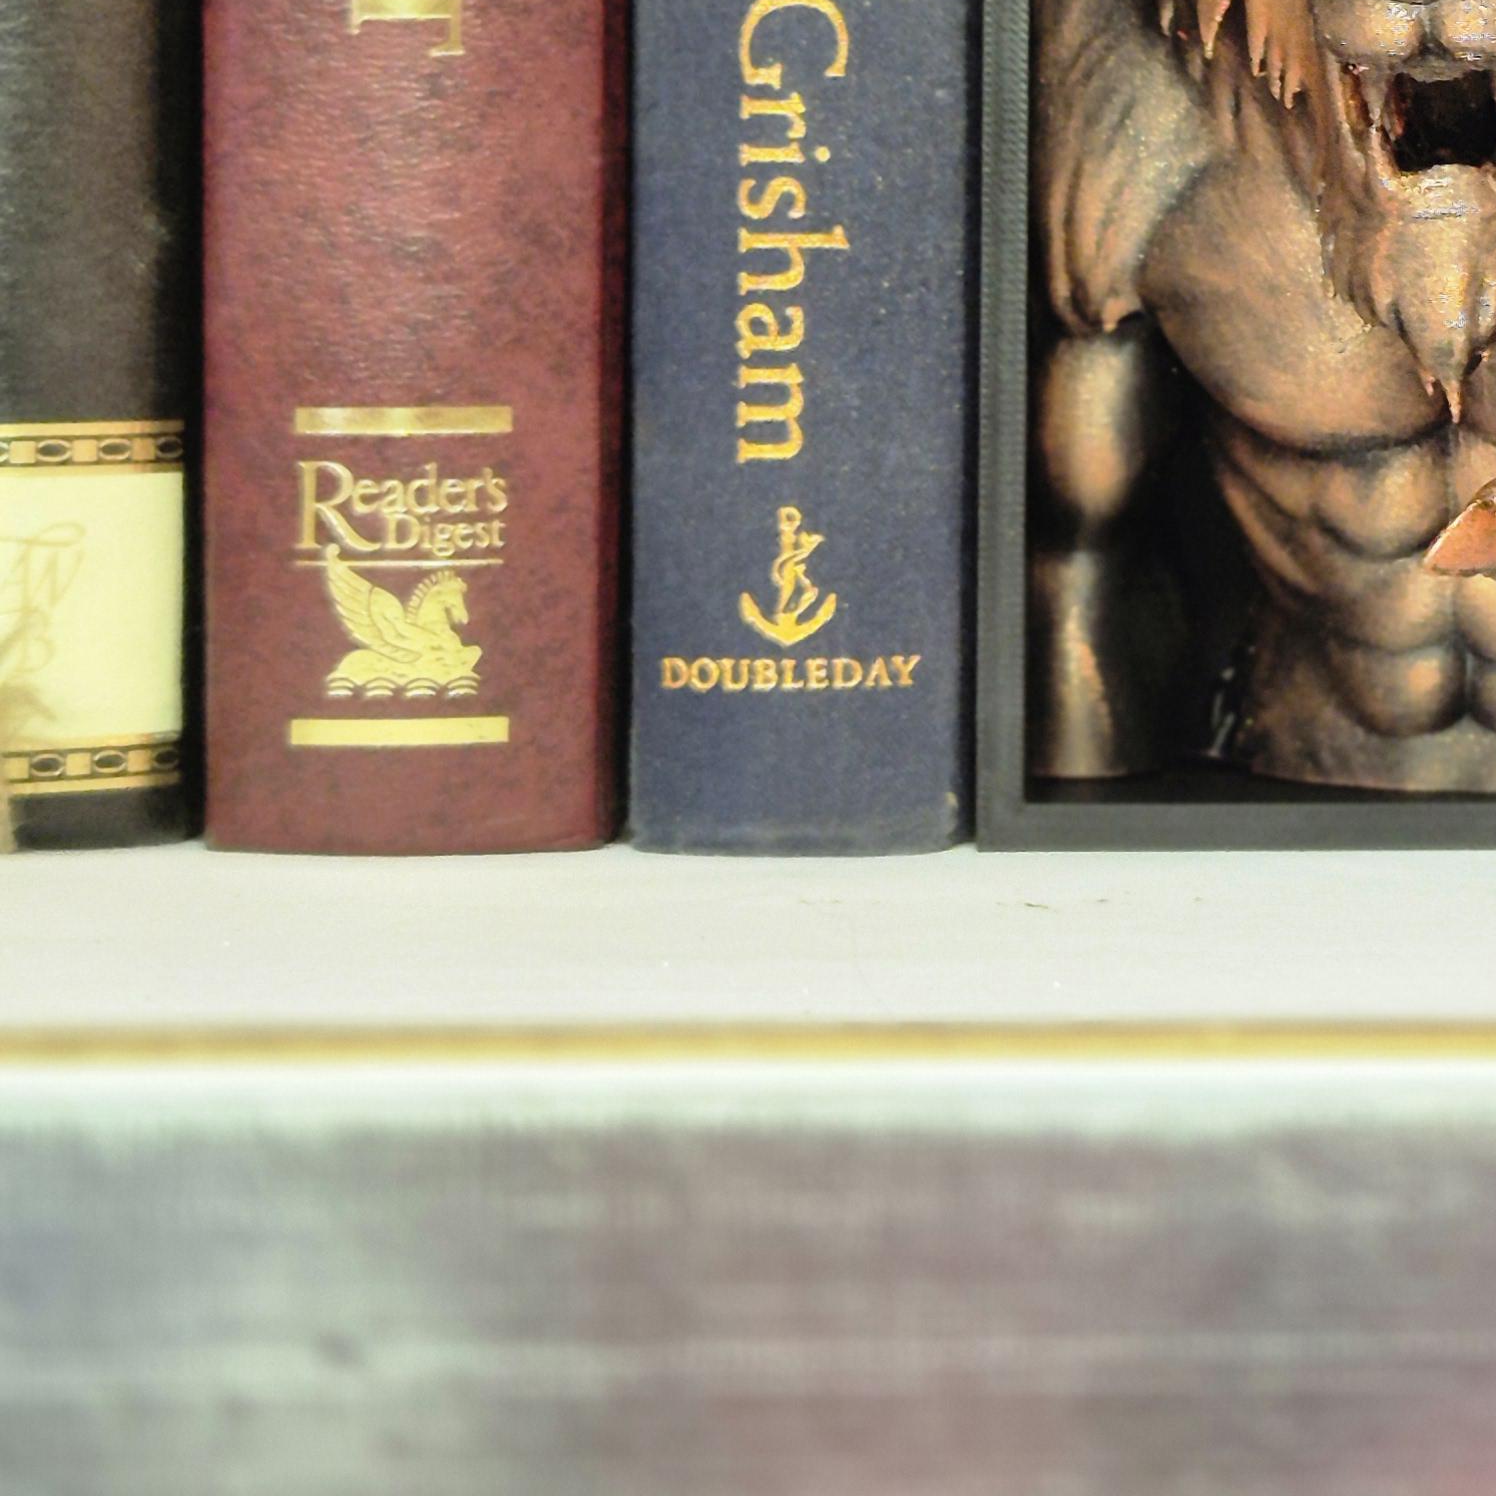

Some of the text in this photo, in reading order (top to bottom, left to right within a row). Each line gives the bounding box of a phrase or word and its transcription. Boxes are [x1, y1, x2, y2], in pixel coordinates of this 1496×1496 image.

[296, 460, 508, 551] Reader's
[384, 513, 505, 557] Digest
[660, 654, 921, 692] DOUBLEDAY
